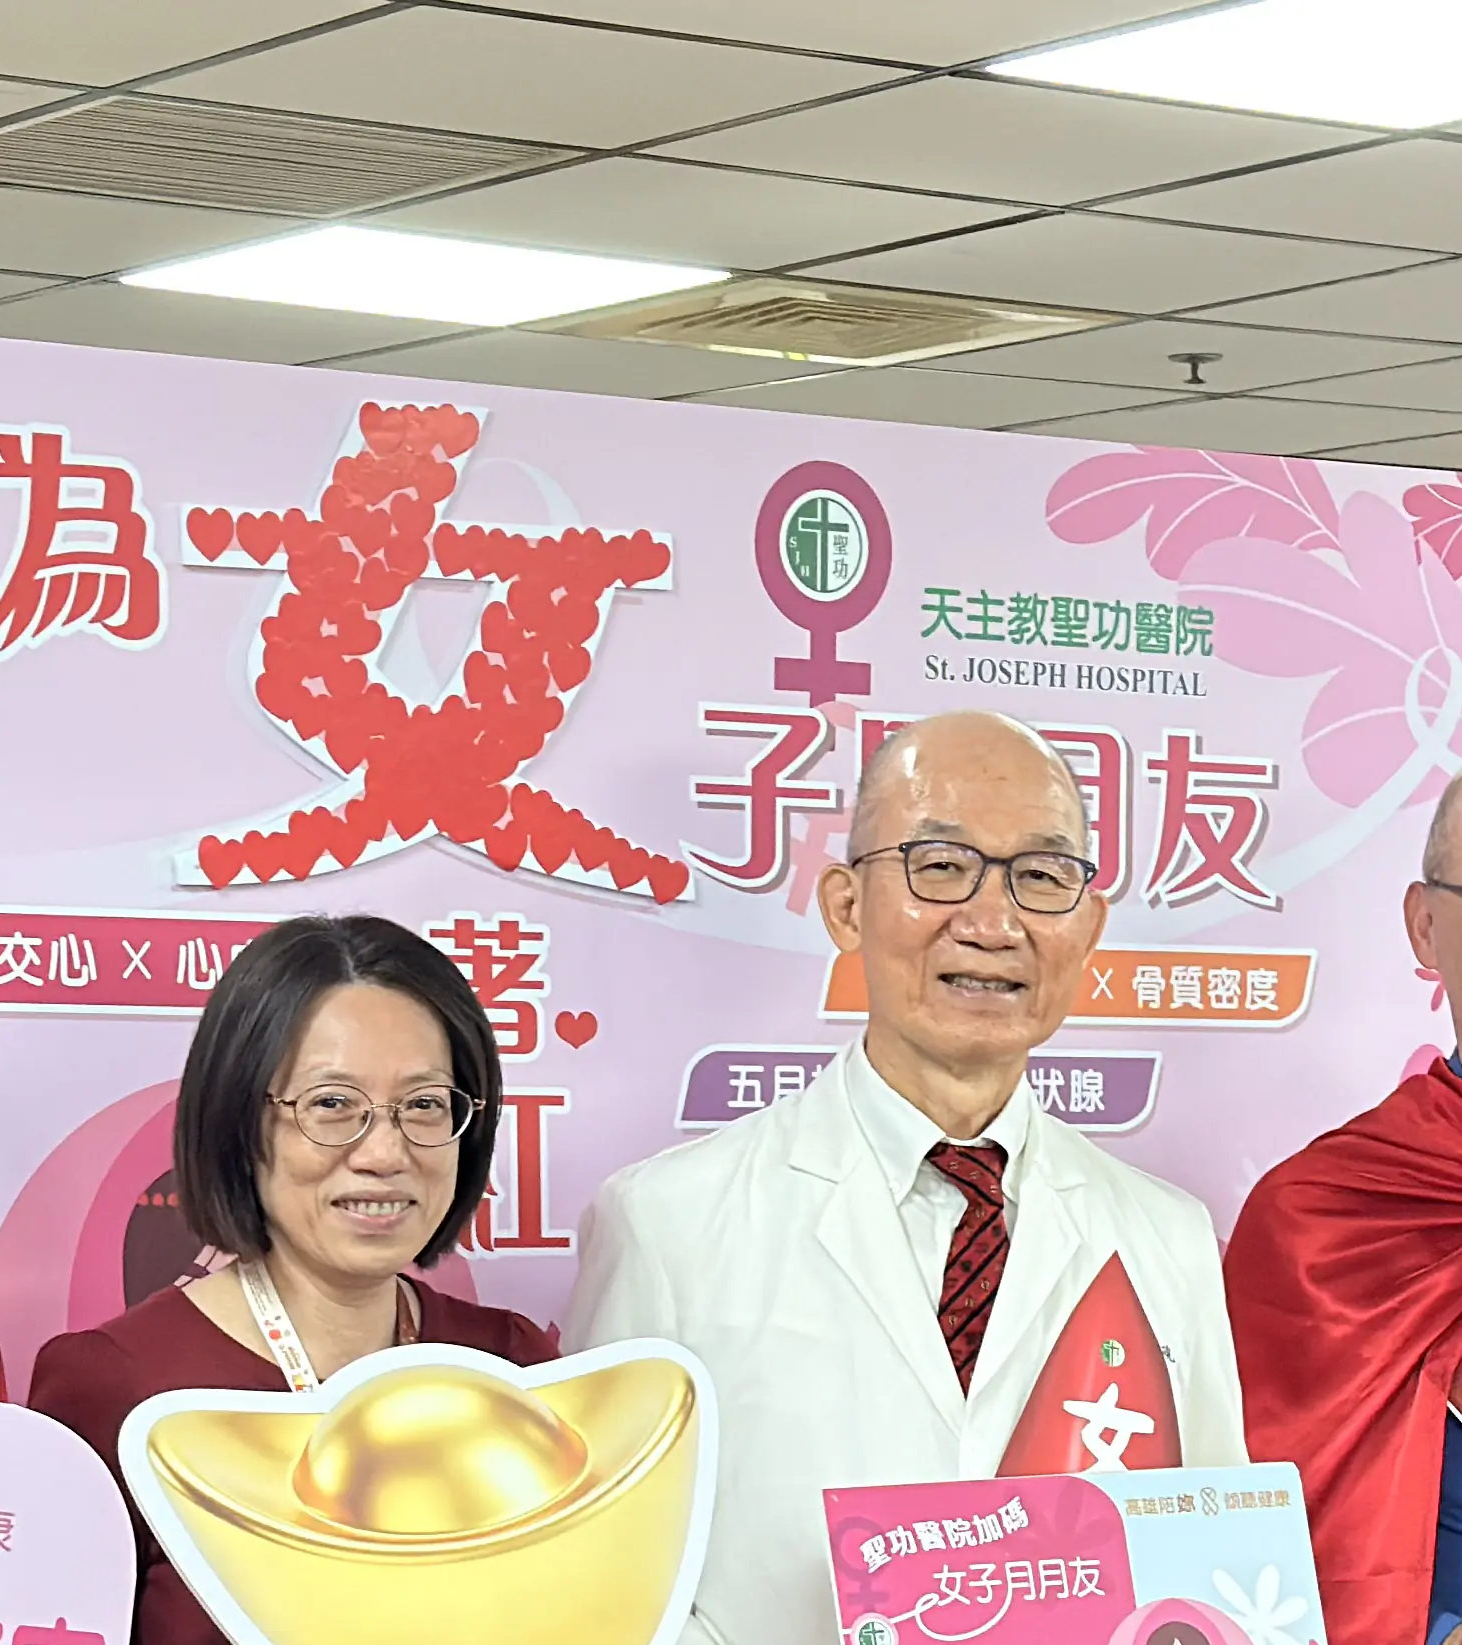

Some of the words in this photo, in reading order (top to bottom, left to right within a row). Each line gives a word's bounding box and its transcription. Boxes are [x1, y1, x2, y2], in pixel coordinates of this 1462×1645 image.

[832, 535, 849, 579] 聖功
[920, 586, 1215, 659] 天主教聖功醫院
[177, 402, 695, 904] 女
[925, 654, 958, 683] St.
[964, 658, 1067, 690] JOSEPH
[1076, 664, 1207, 698] HOSPITAL
[1131, 967, 1280, 1012] 骨質密度
[727, 1063, 825, 1110] 五月
[1062, 1381, 1155, 1473] 女
[858, 1496, 1029, 1574] 聖功醫院加碼
[933, 1556, 1106, 1607] 女子月月友
